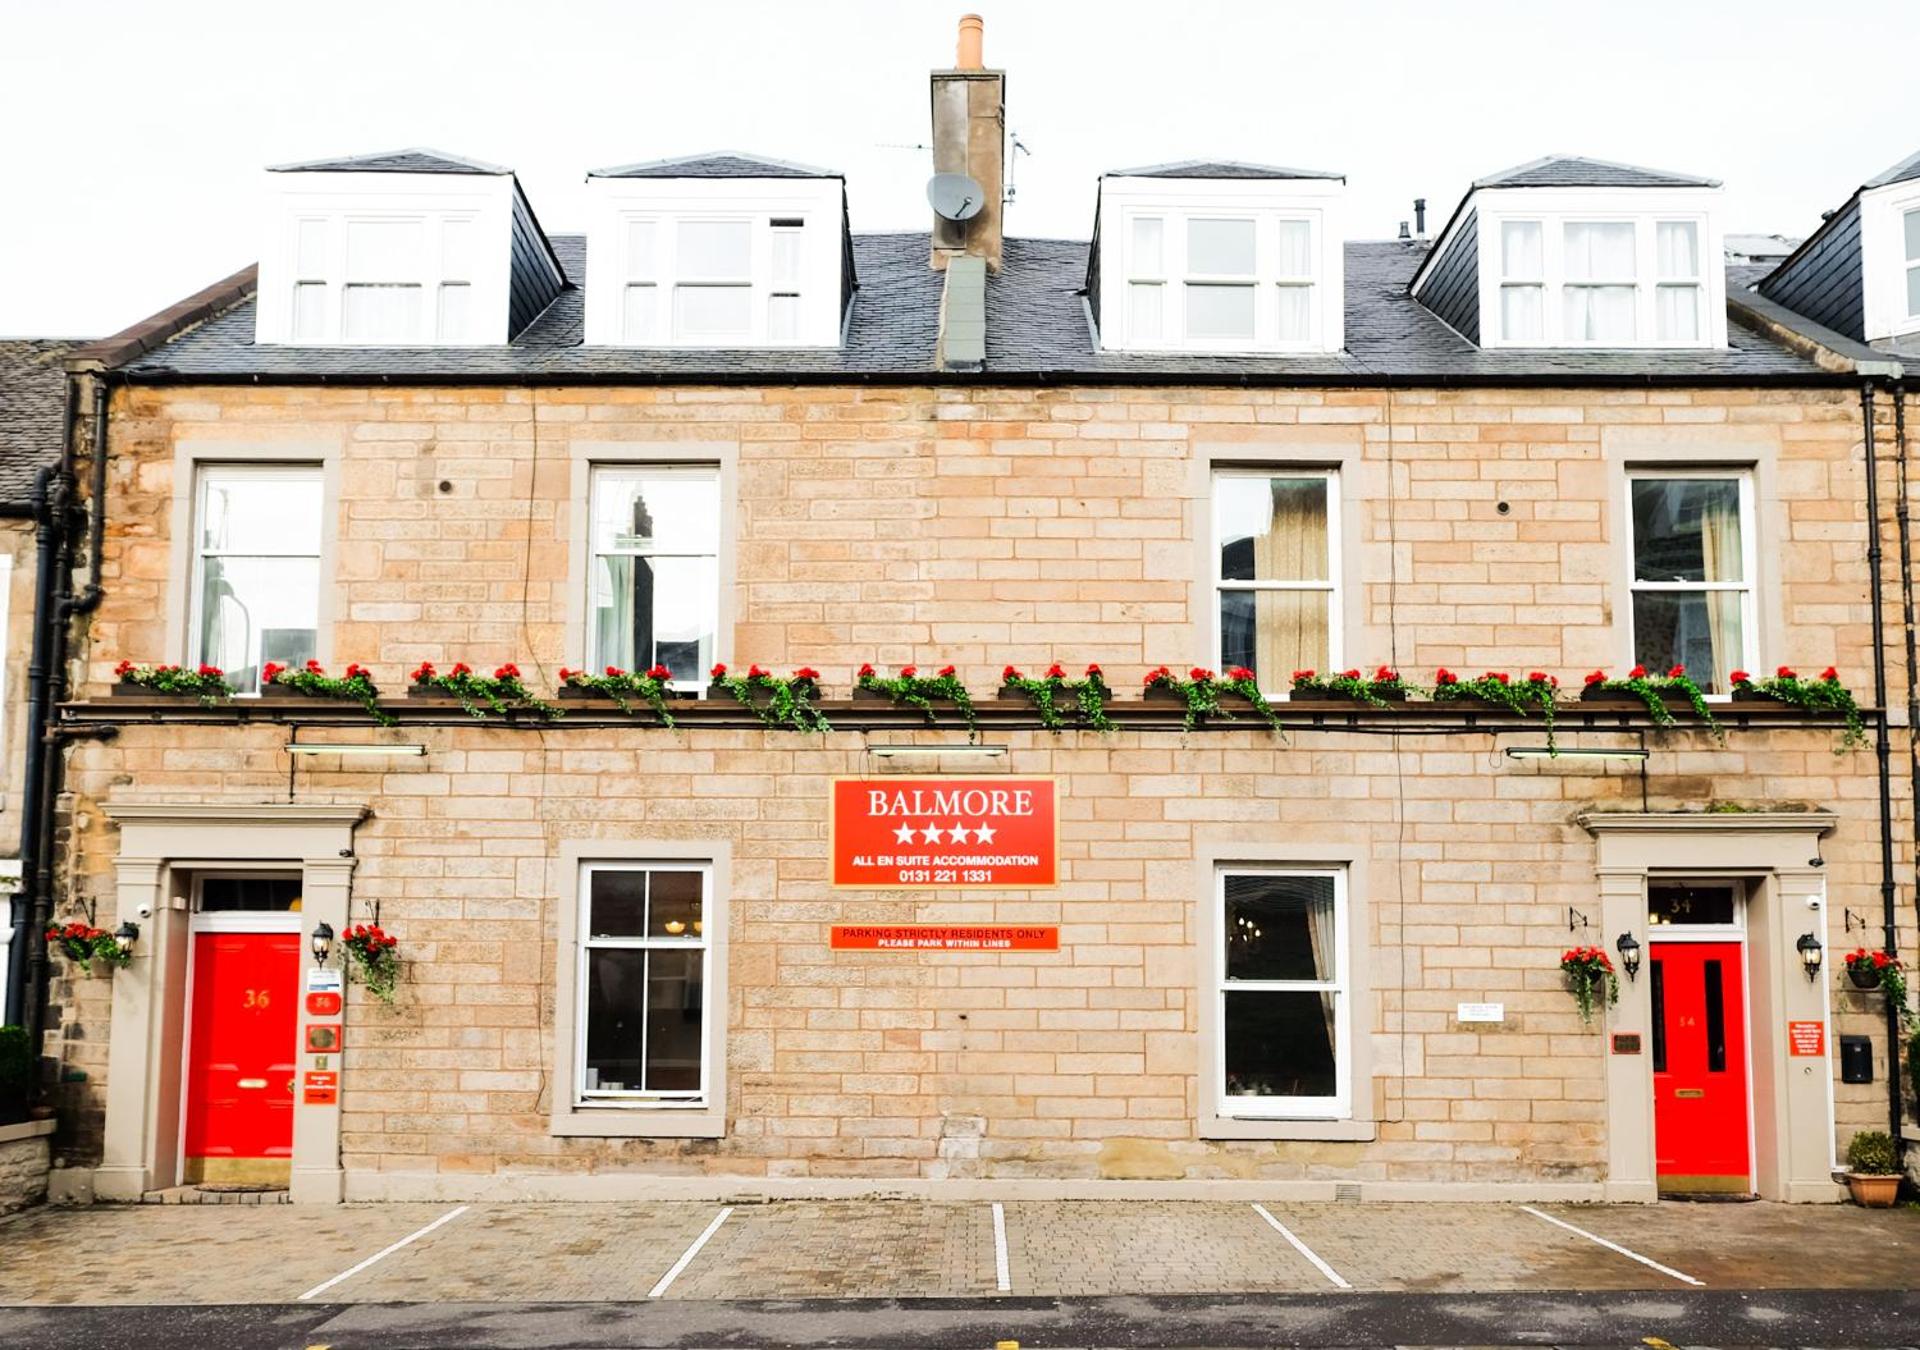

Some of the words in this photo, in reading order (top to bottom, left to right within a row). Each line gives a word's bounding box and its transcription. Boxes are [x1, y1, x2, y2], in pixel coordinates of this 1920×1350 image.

[867, 789, 1034, 817] BALMORE
[852, 855, 875, 867] ALL
[877, 855, 894, 867] EN
[896, 855, 930, 867] SUITE
[932, 855, 1039, 867] ACCOMMODATION
[899, 869, 931, 882] 0131
[934, 869, 957, 882] 221
[962, 869, 992, 882] 1331
[1670, 898, 1692, 914] 34
[842, 928, 892, 938] PARKING
[895, 928, 948, 939] STRICTLY
[950, 928, 1014, 939] RESIDENTS
[1016, 929, 1046, 939] ONLY
[877, 938, 916, 947] PLEASE
[917, 938, 943, 947] PARK
[945, 938, 981, 948] WITHIN
[983, 939, 1011, 948] LINES
[242, 989, 271, 1009] 36
